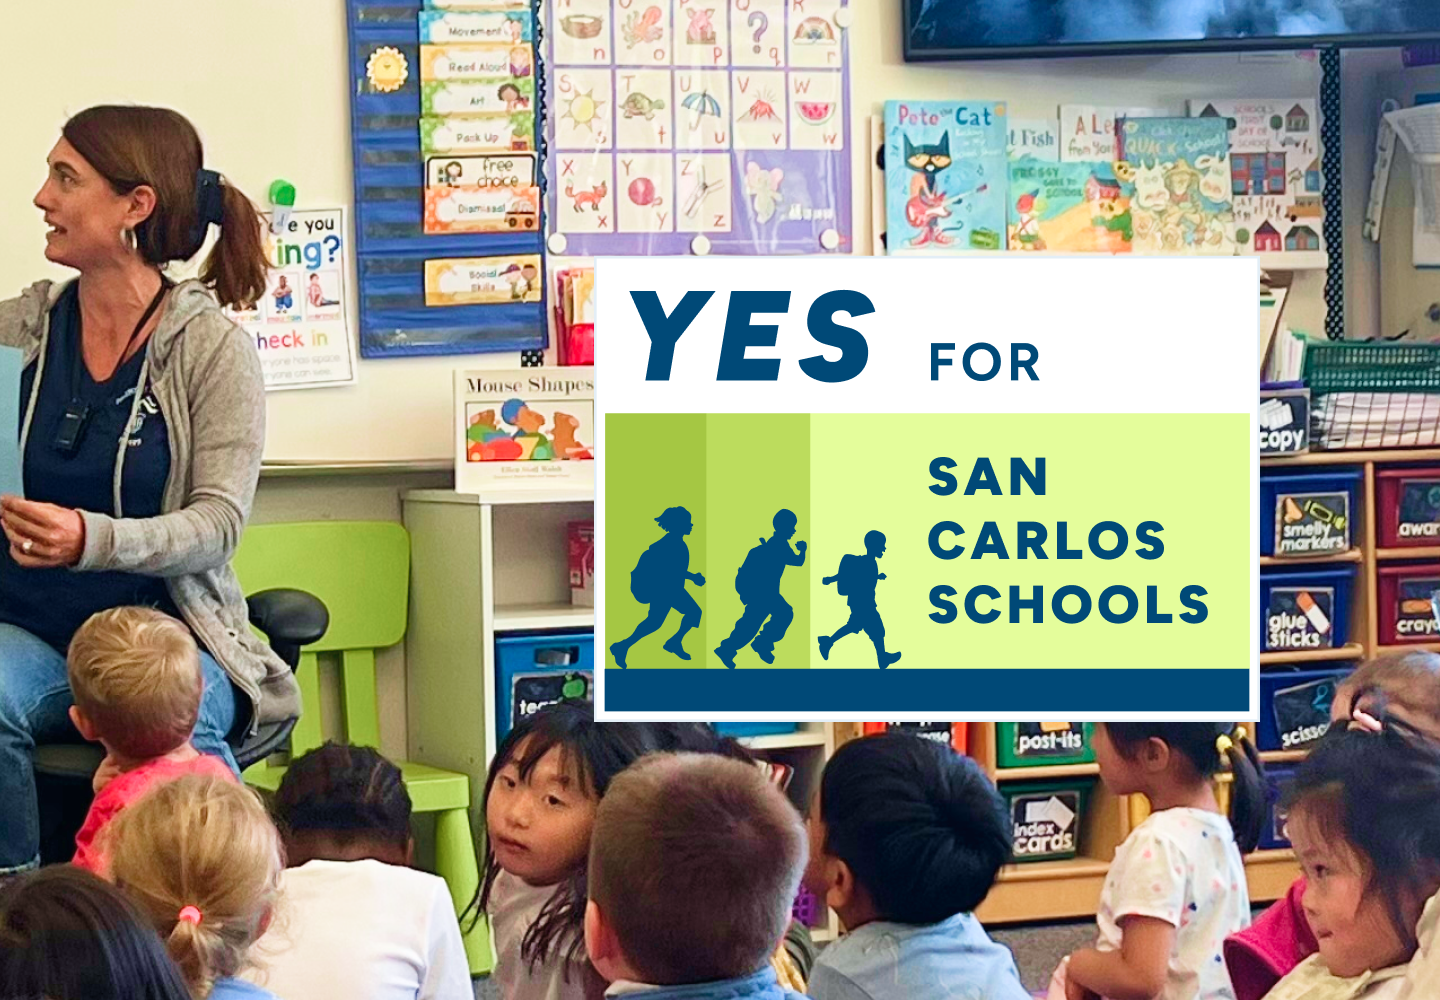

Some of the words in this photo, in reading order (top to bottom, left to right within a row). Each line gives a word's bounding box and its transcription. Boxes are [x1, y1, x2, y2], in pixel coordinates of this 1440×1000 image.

[449, 27, 501, 36] Movement
[593, 48, 605, 59] n
[654, 49, 665, 60] o
[713, 47, 723, 64] p
[769, 47, 781, 66] q
[827, 51, 835, 63] r
[449, 62, 475, 72] Read
[479, 62, 507, 72] Aloud
[559, 74, 572, 93] S
[622, 75, 635, 92] T
[680, 75, 692, 92] U
[737, 76, 750, 93] V
[794, 78, 810, 94] W
[470, 97, 485, 106] Art
[899, 104, 939, 126] Pete
[955, 106, 992, 126] Cat
[1076, 116, 1086, 135] A
[457, 133, 479, 143] Pack
[484, 132, 499, 143] Up
[658, 125, 666, 144] t
[714, 132, 725, 143] u
[772, 133, 781, 144] v
[823, 133, 837, 144] w
[1021, 129, 1054, 147] Fish
[562, 159, 574, 175] X
[621, 159, 633, 176] Y
[681, 160, 694, 176] Z
[477, 175, 518, 187] choice
[458, 204, 506, 214] Dismissal
[305, 218, 335, 235] you
[597, 215, 607, 228] x
[656, 211, 669, 230] y
[714, 214, 725, 227] z
[254, 330, 304, 350] heck
[311, 329, 328, 346] in
[467, 378, 522, 393] Mouse
[529, 376, 594, 395] Shapes
[1260, 429, 1304, 451] copy
[1284, 521, 1331, 540] smelly
[1399, 522, 1440, 536] awar
[1281, 536, 1344, 551] markers
[1269, 612, 1307, 633] glue
[1269, 630, 1320, 647] sticks
[1019, 731, 1082, 752] post-its
[1282, 722, 1331, 747] scisso
[1014, 822, 1056, 838] index
[1013, 832, 1074, 854] cards
